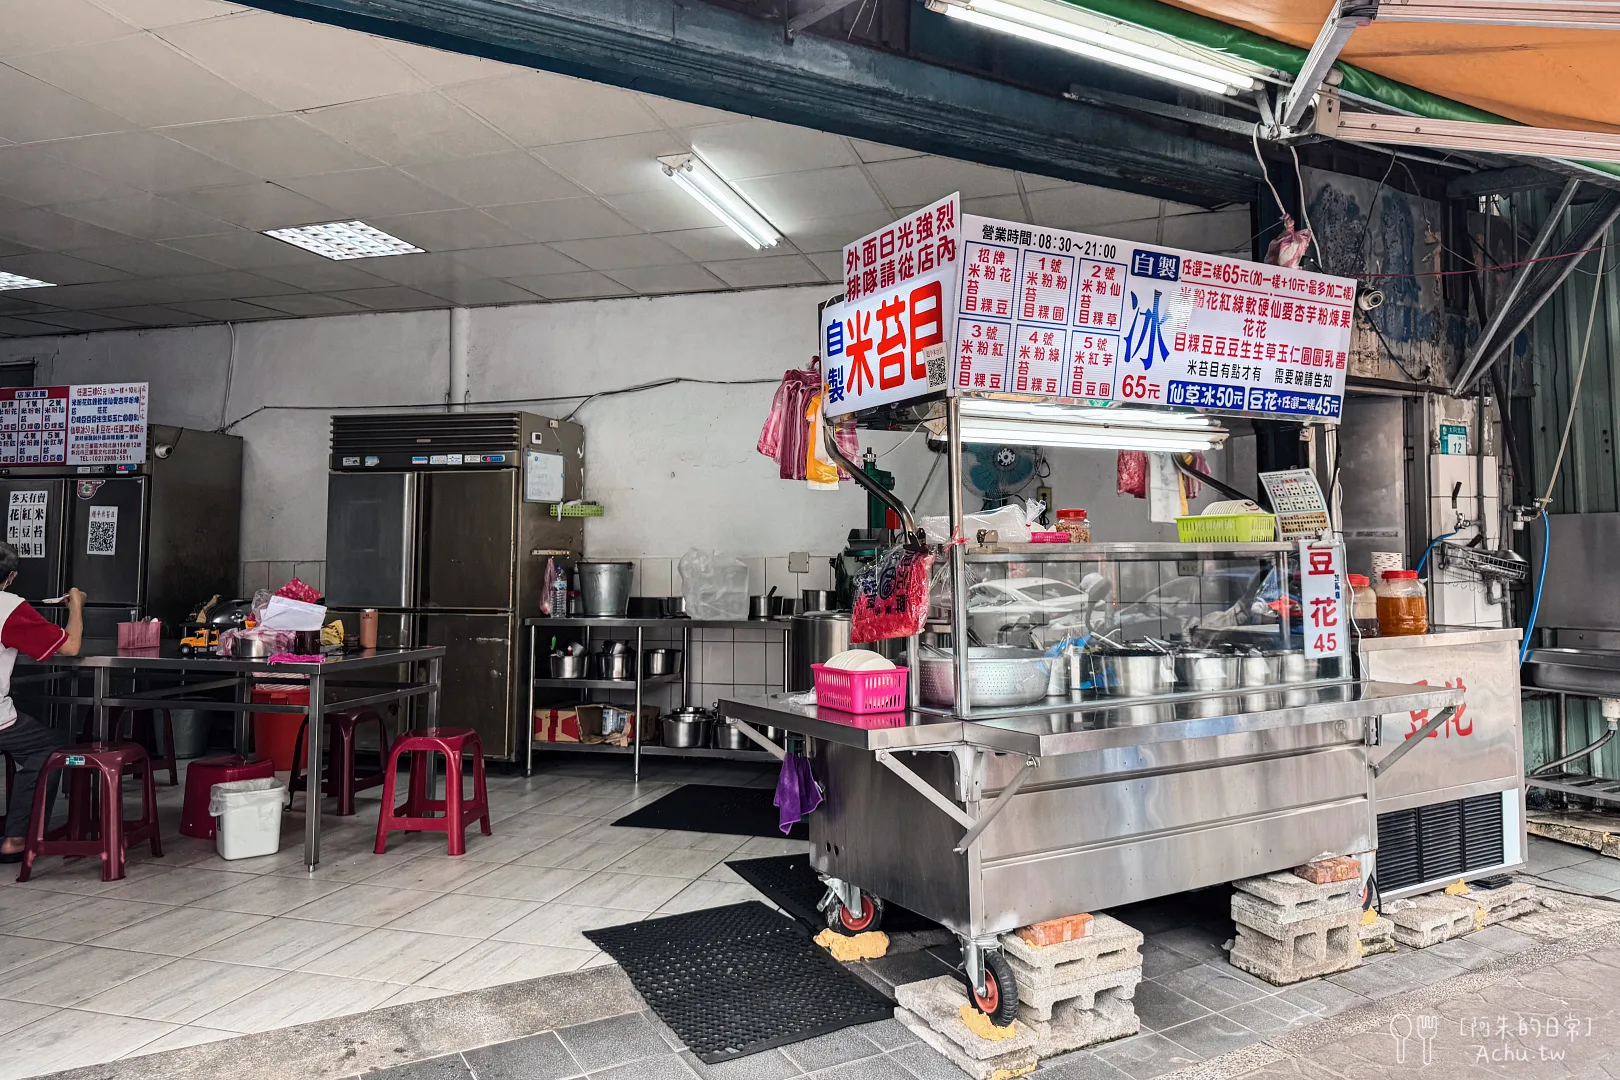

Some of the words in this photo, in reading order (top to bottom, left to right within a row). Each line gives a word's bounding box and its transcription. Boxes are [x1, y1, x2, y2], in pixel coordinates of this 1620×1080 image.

[846, 200, 955, 275] 外面日光強烈
[978, 247, 1005, 265] 招牌
[1039, 258, 1062, 273] 1號
[1134, 252, 1177, 279] 自製
[846, 235, 956, 303] 排隊請從店內
[1091, 265, 1116, 281] 2號
[846, 280, 944, 397] 米苔目
[972, 325, 998, 341] 3號
[1029, 331, 1054, 346] 4號
[1124, 289, 1170, 371] 冰
[1084, 337, 1107, 352] 5號
[826, 319, 845, 405] 自製
[1187, 360, 1262, 381] 米苔目有點才有
[1274, 368, 1332, 388] 需要碗請告知
[1122, 374, 1160, 399] 65元
[1170, 383, 1243, 406] 仙草冰50元
[1250, 390, 1339, 415] 豆花+任選二樣45元
[1454, 443, 1462, 453] 12
[12, 493, 45, 503] 冬天有賣
[21, 508, 31, 555] 紅豆湯
[34, 508, 44, 555] 米苔目
[1307, 546, 1337, 627] 豆花
[1314, 633, 1336, 652] 45
